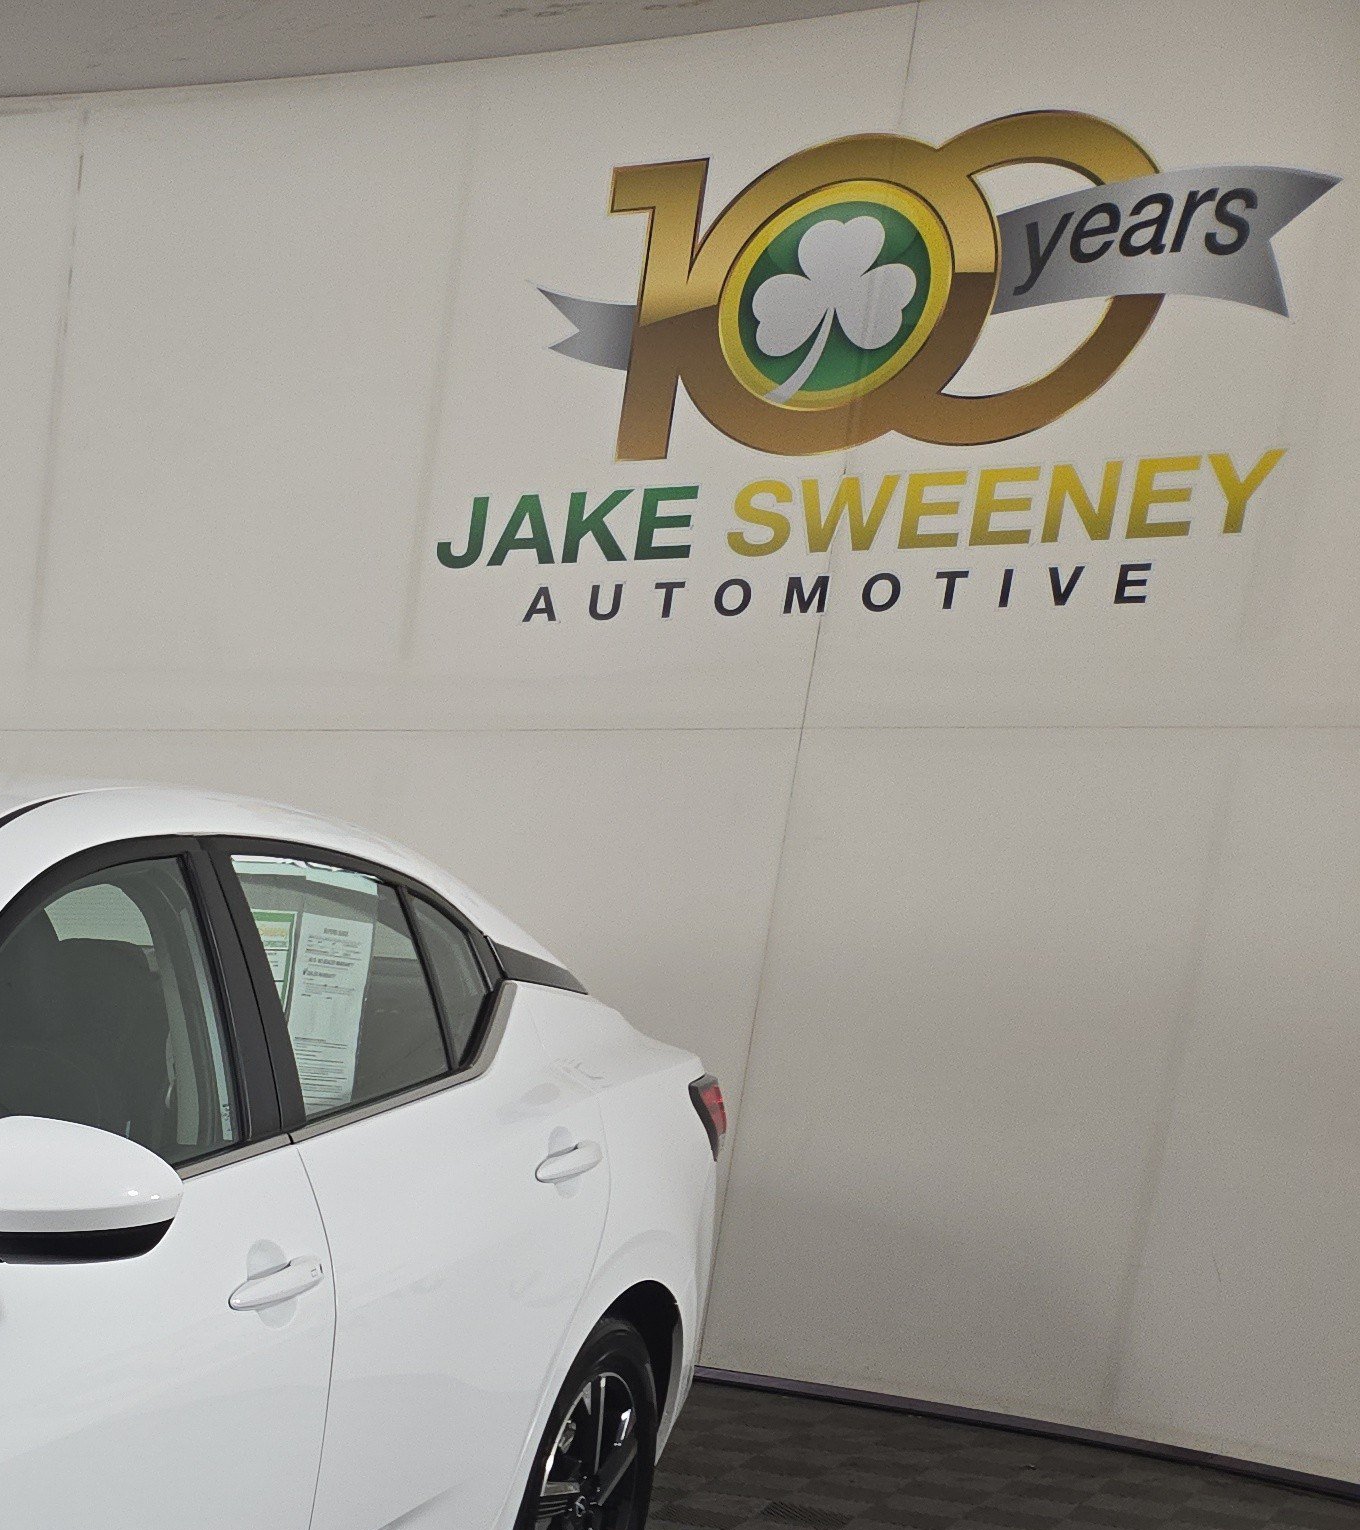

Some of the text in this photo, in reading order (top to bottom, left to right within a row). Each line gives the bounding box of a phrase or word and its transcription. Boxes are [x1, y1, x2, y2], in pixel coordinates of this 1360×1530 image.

[1013, 186, 1258, 296] years
[436, 448, 1288, 569] JAKE SWEENEY
[522, 562, 1153, 624] AUTOMOTIVE
